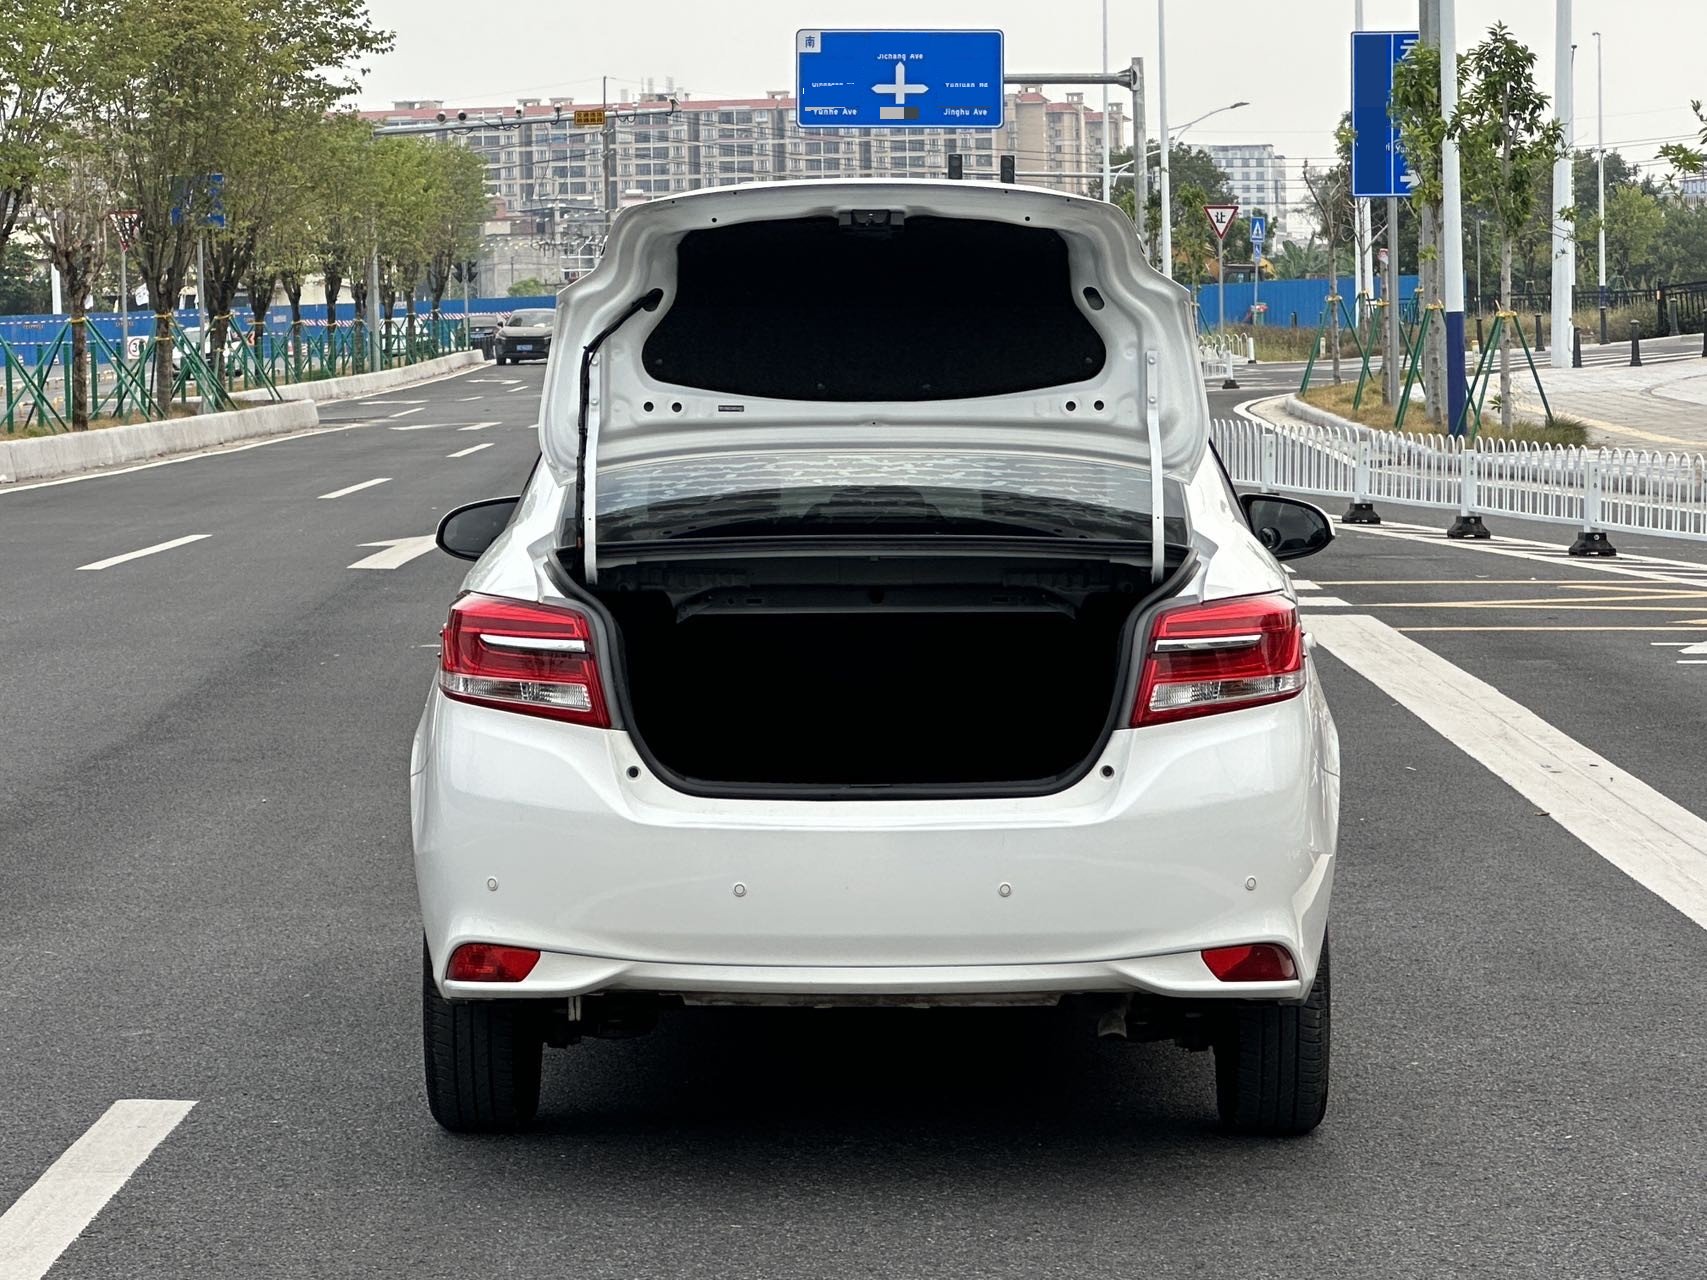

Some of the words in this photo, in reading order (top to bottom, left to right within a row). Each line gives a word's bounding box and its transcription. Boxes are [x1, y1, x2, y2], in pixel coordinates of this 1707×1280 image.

[804, 35, 815, 48] 南
[877, 53, 906, 61] Jichang
[943, 108, 970, 117] Jinghu
[973, 108, 988, 116] Ave
[1215, 211, 1226, 223] 让
